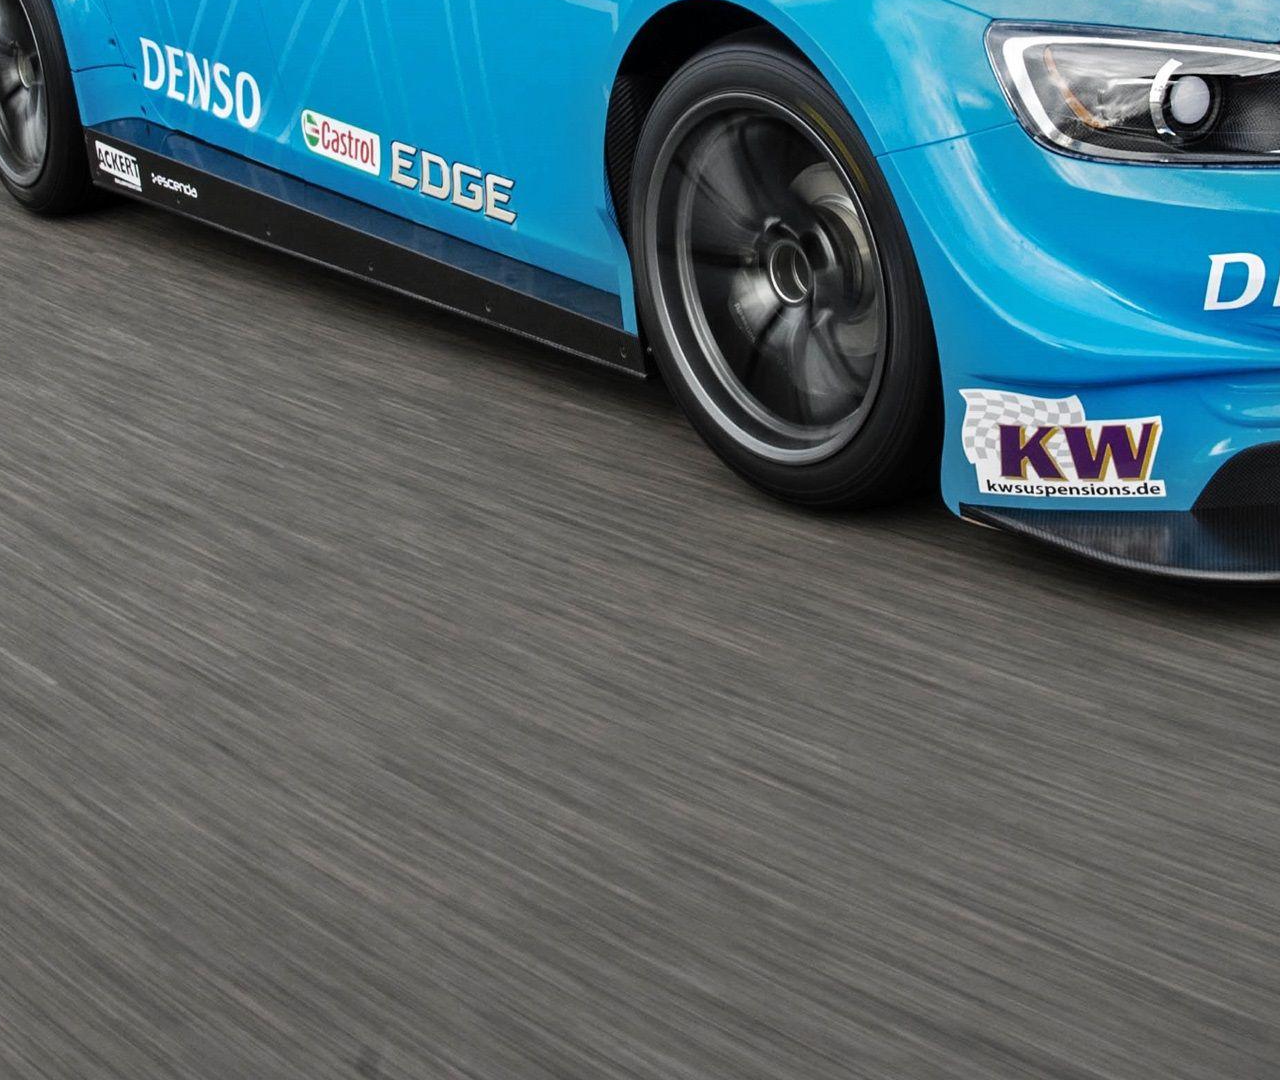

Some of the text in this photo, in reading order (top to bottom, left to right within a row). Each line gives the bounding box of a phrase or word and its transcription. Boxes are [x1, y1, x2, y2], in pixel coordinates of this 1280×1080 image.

[139, 36, 261, 130] DENSO
[321, 121, 518, 225] Castrol EDGE
[986, 479, 1161, 497] kwsuspensions.de
[998, 422, 1160, 481] KW
